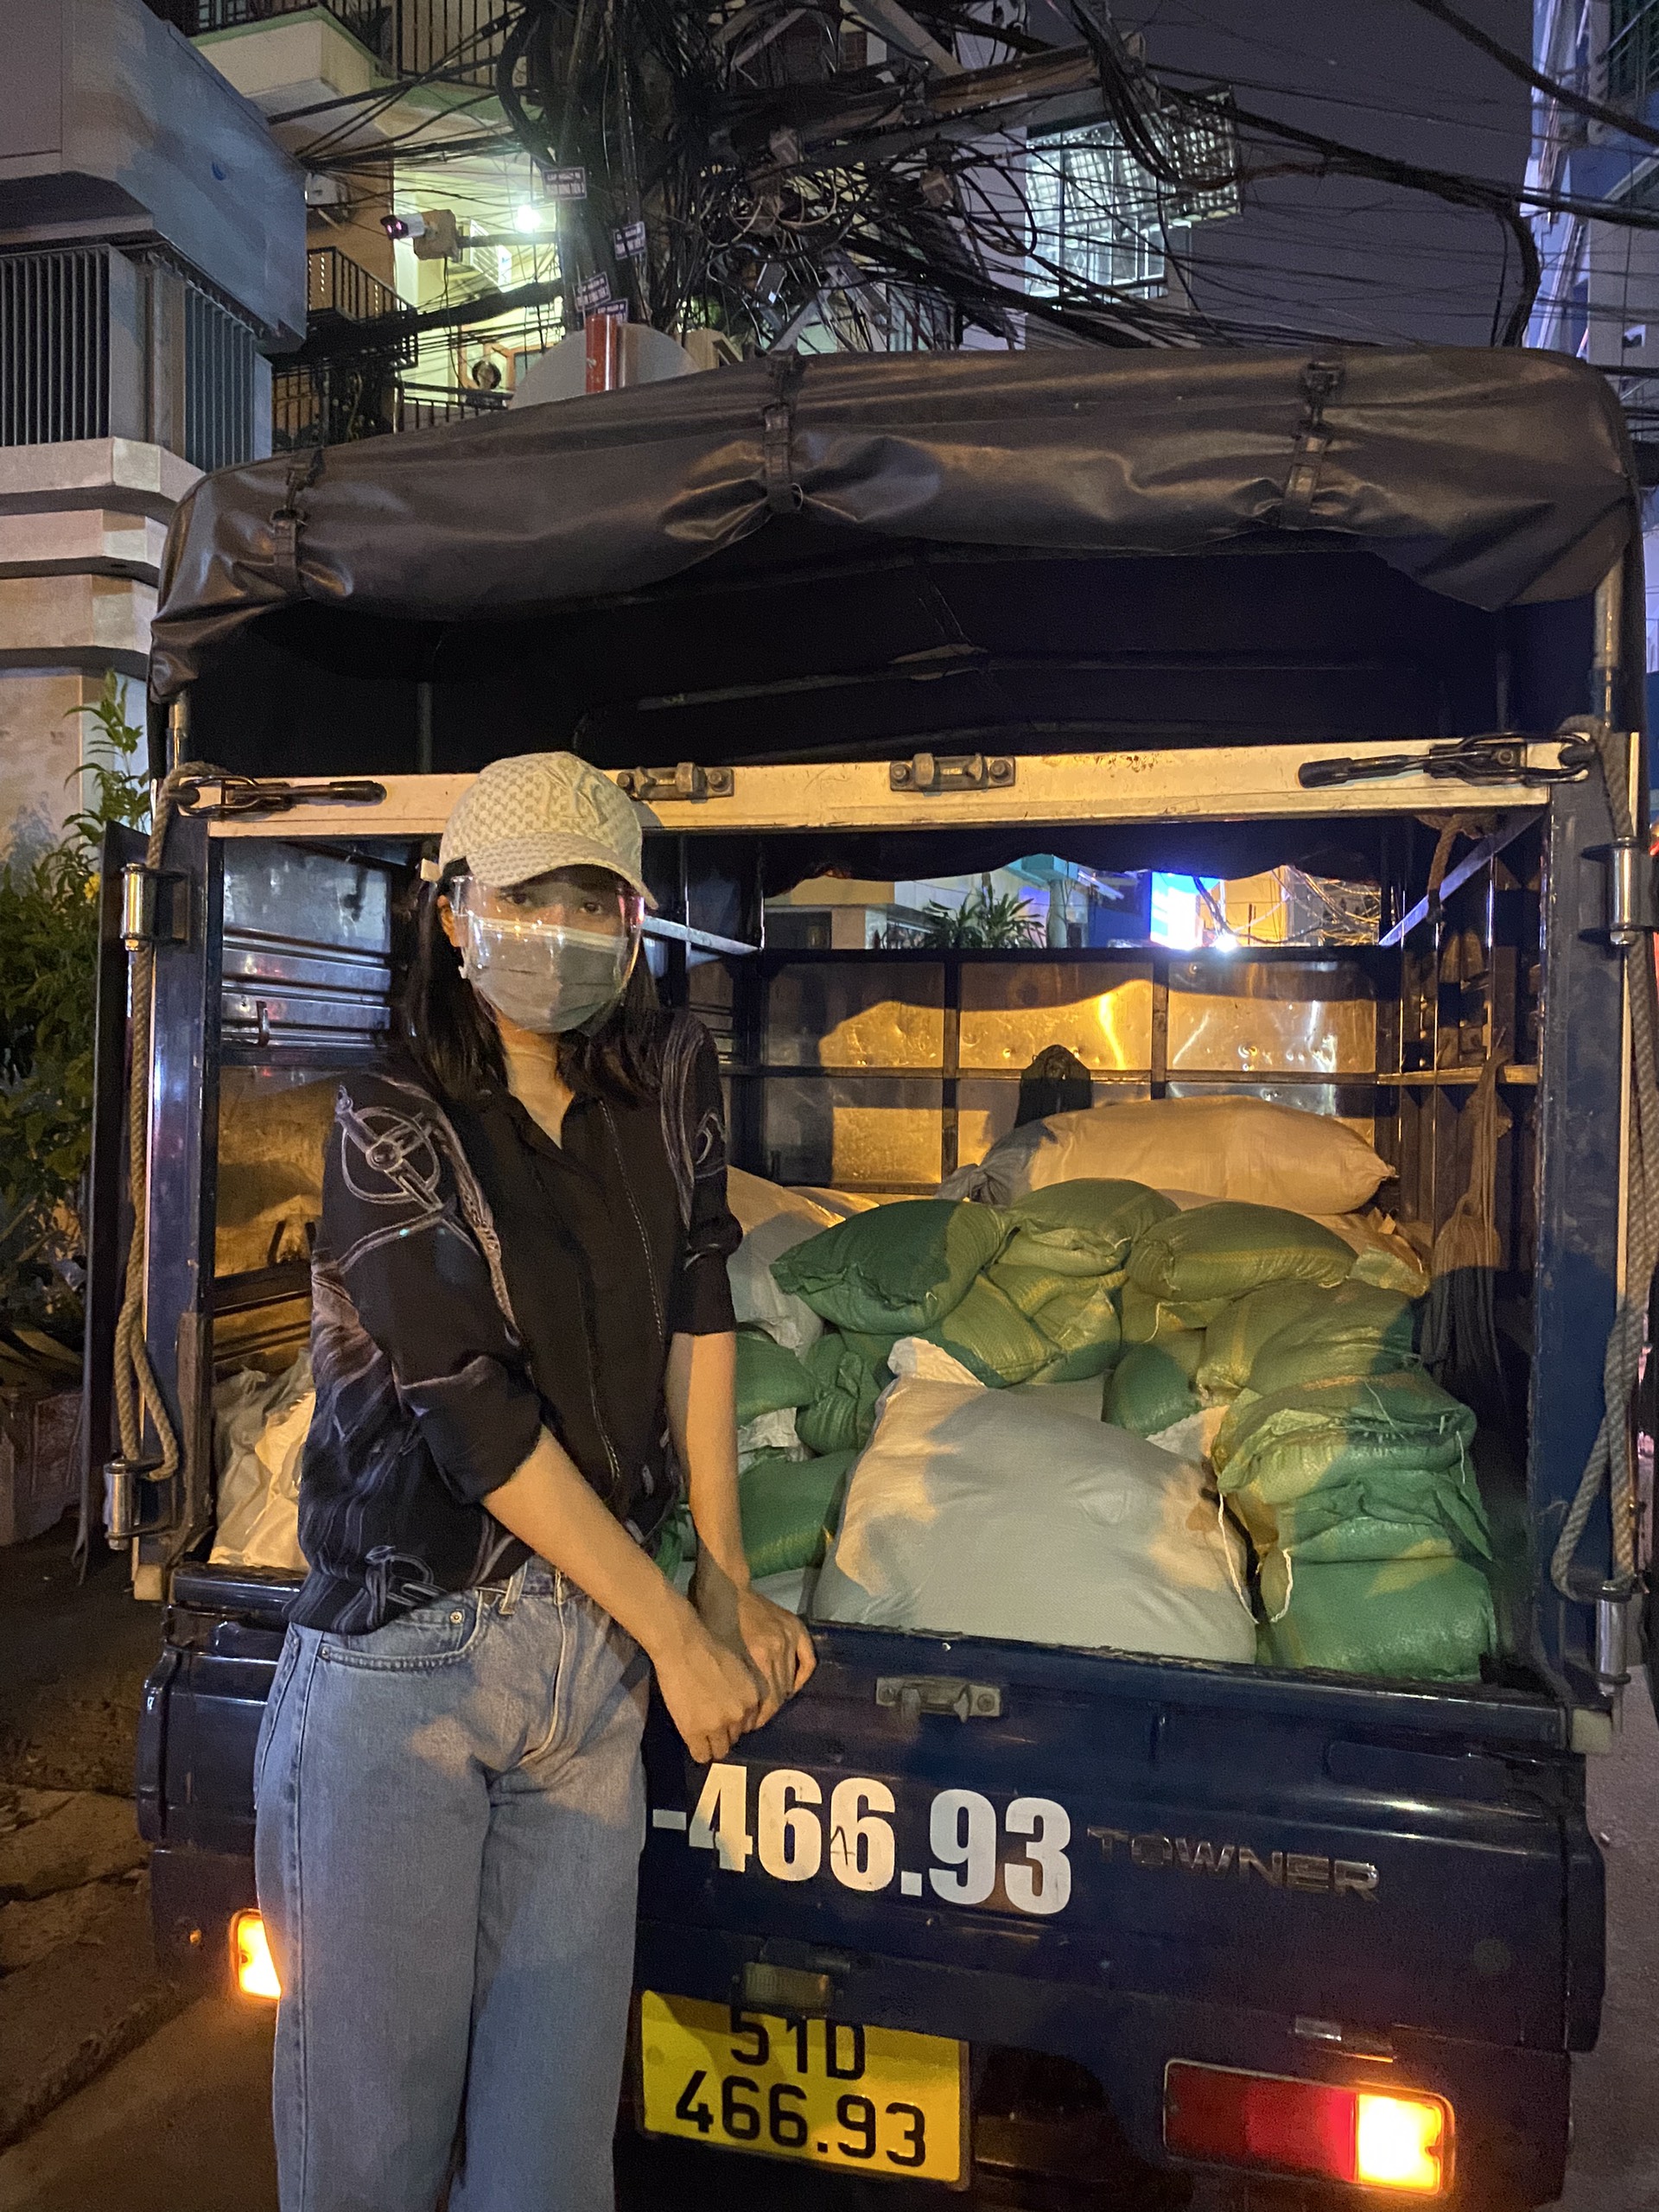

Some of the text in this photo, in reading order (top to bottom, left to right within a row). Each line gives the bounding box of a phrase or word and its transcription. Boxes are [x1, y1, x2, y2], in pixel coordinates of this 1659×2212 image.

[652, 1763, 1071, 1916] -466.93
[1086, 1826, 1380, 1903] TOWNER
[731, 2005, 865, 2081] 51D
[675, 2069, 927, 2168] 466.93
